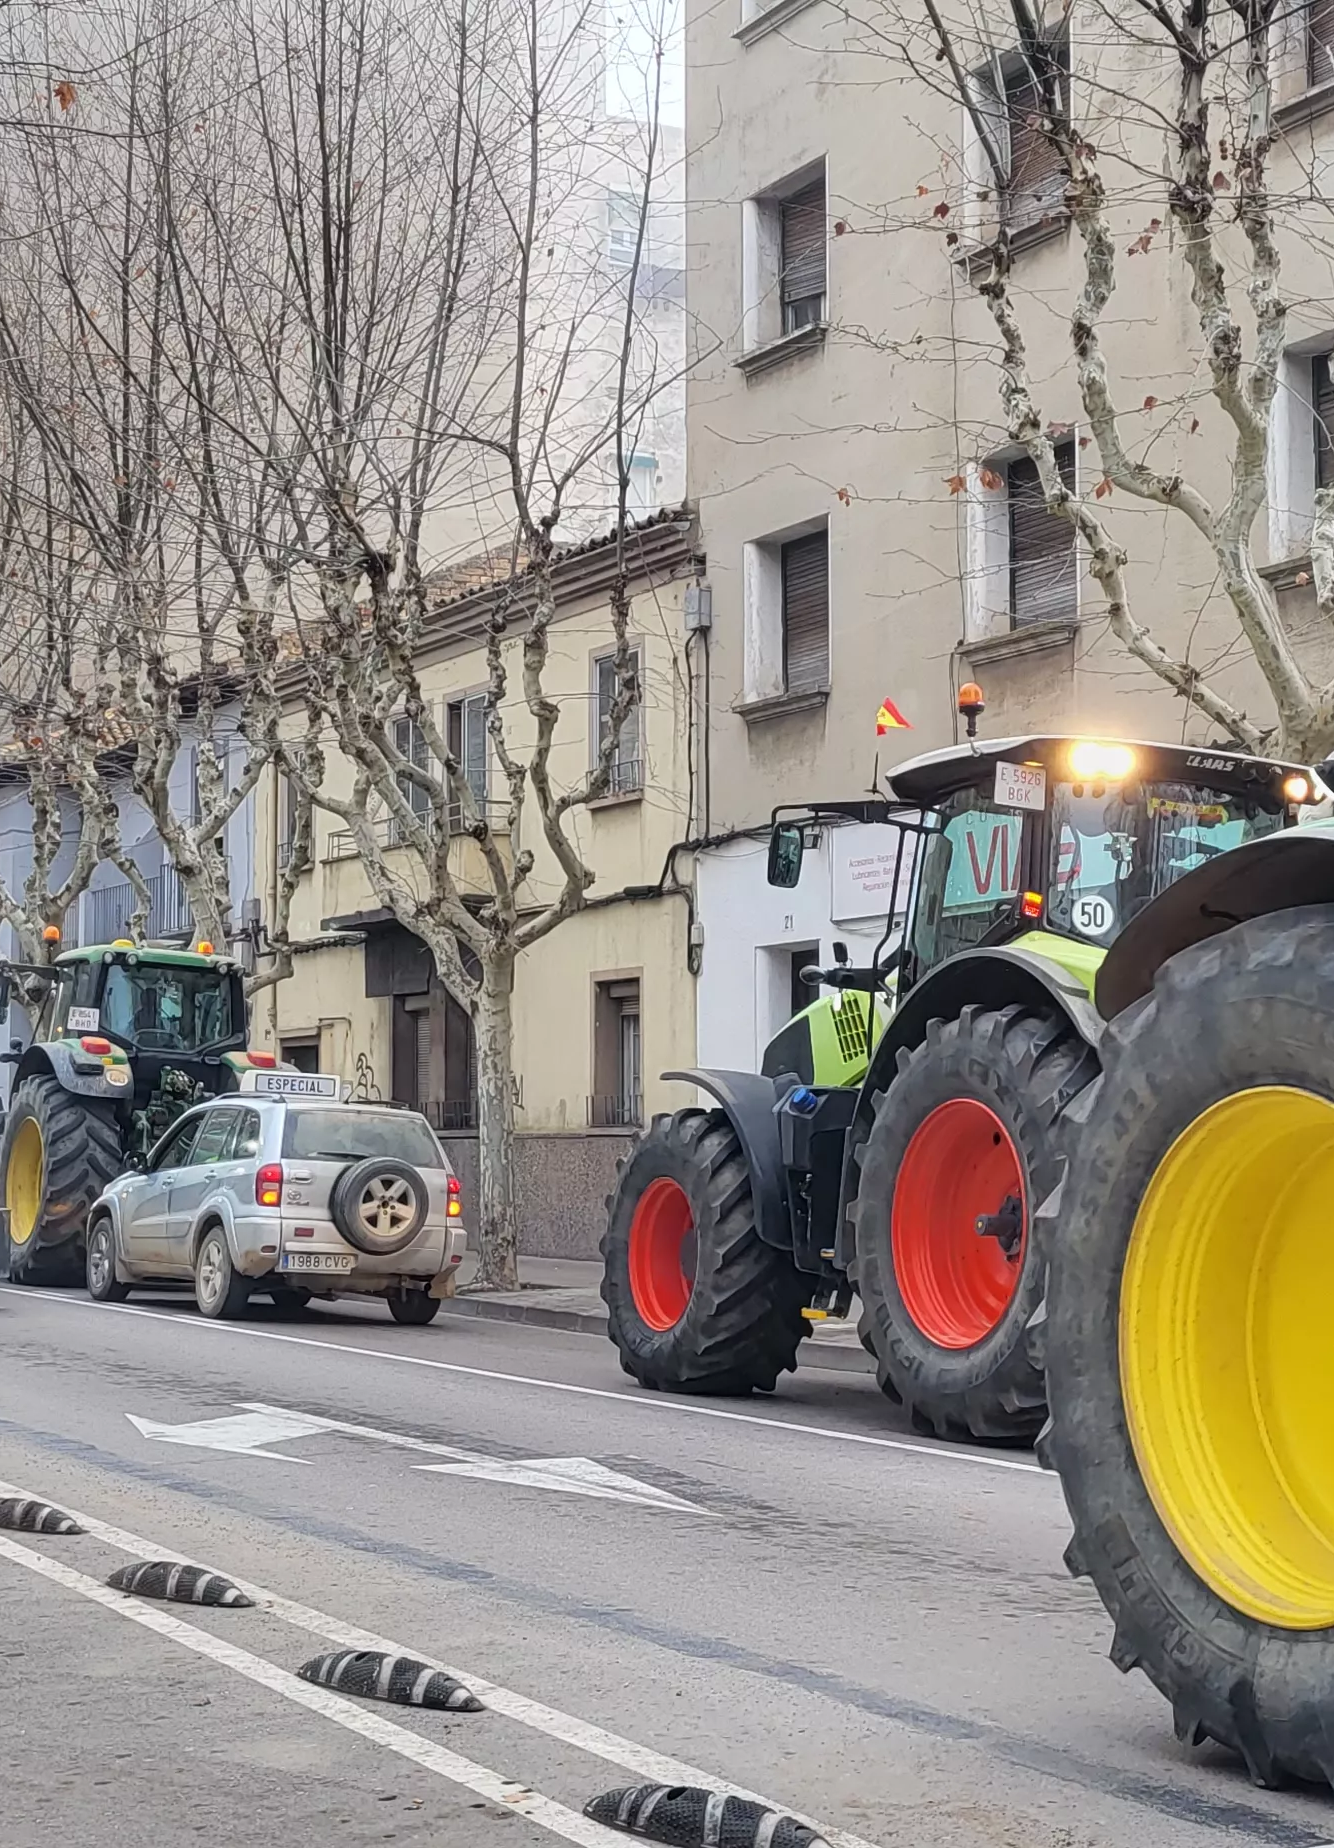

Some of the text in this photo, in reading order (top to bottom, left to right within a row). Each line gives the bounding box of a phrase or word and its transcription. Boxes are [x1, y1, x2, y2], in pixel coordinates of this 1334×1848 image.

[1186, 755, 1236, 772] CLAAS
[1000, 767, 1042, 787] E 5926
[1007, 786, 1032, 803] BGK
[784, 915, 794, 930] 21
[1080, 902, 1105, 928] 50
[267, 1077, 324, 1093] ESPECIAL
[291, 1255, 349, 1268] 1988 CVG
